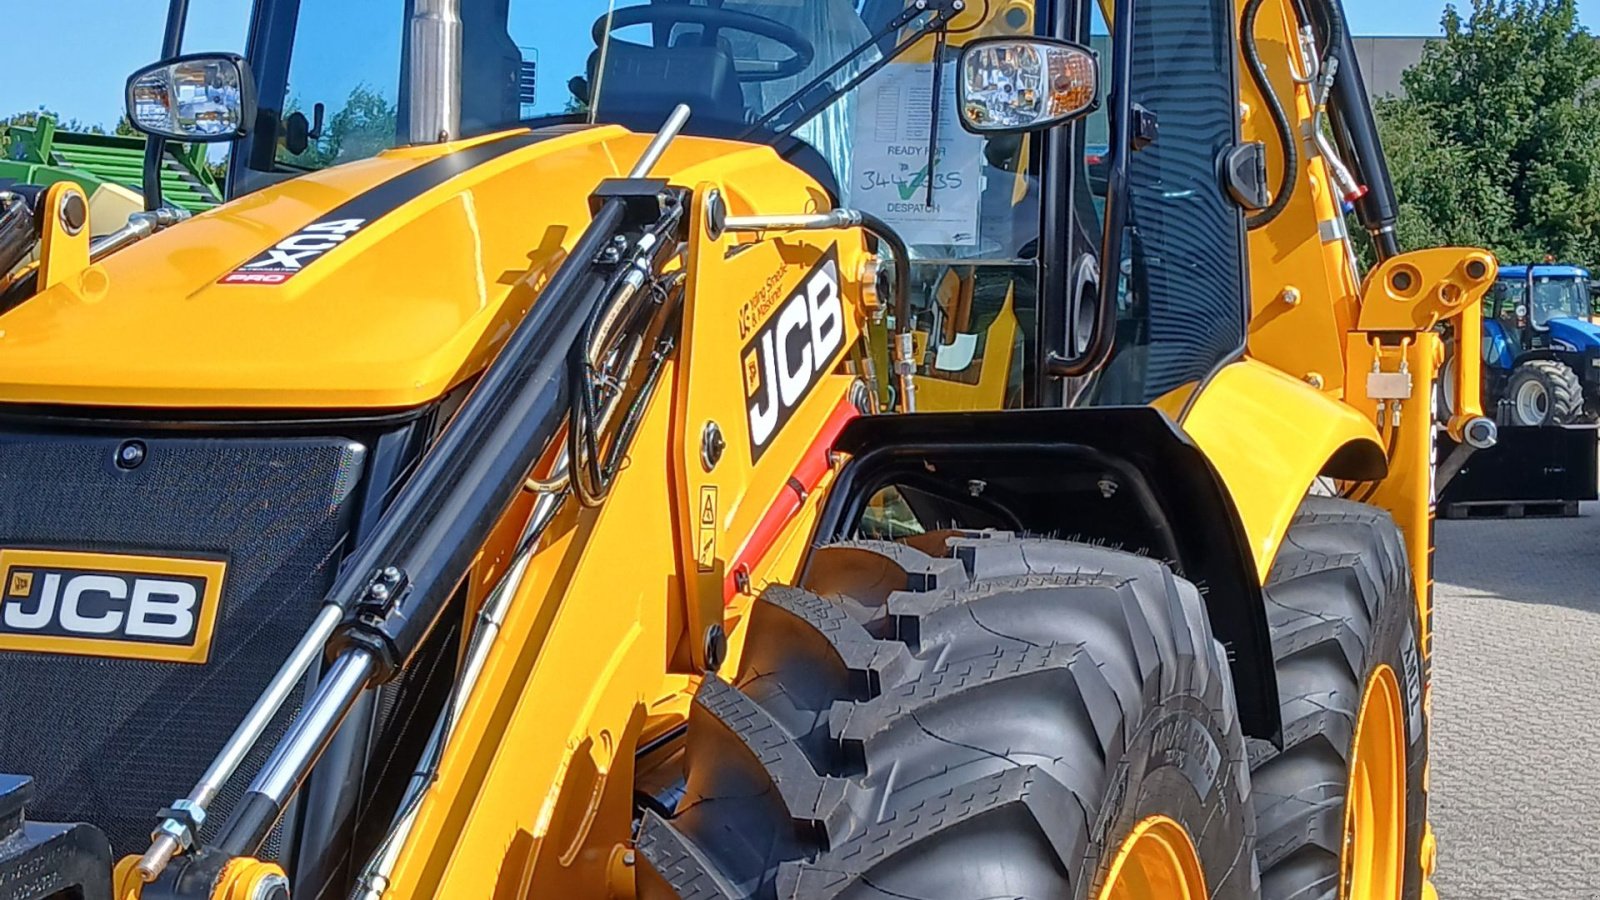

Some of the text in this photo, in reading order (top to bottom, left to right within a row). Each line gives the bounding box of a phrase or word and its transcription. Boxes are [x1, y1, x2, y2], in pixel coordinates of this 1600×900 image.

[887, 145, 923, 156] READY
[887, 203, 940, 213] DESPATCH
[244, 218, 366, 268] 4CX
[225, 274, 285, 283] PRO
[749, 259, 844, 446] JCB
[4, 573, 197, 638] JCB
